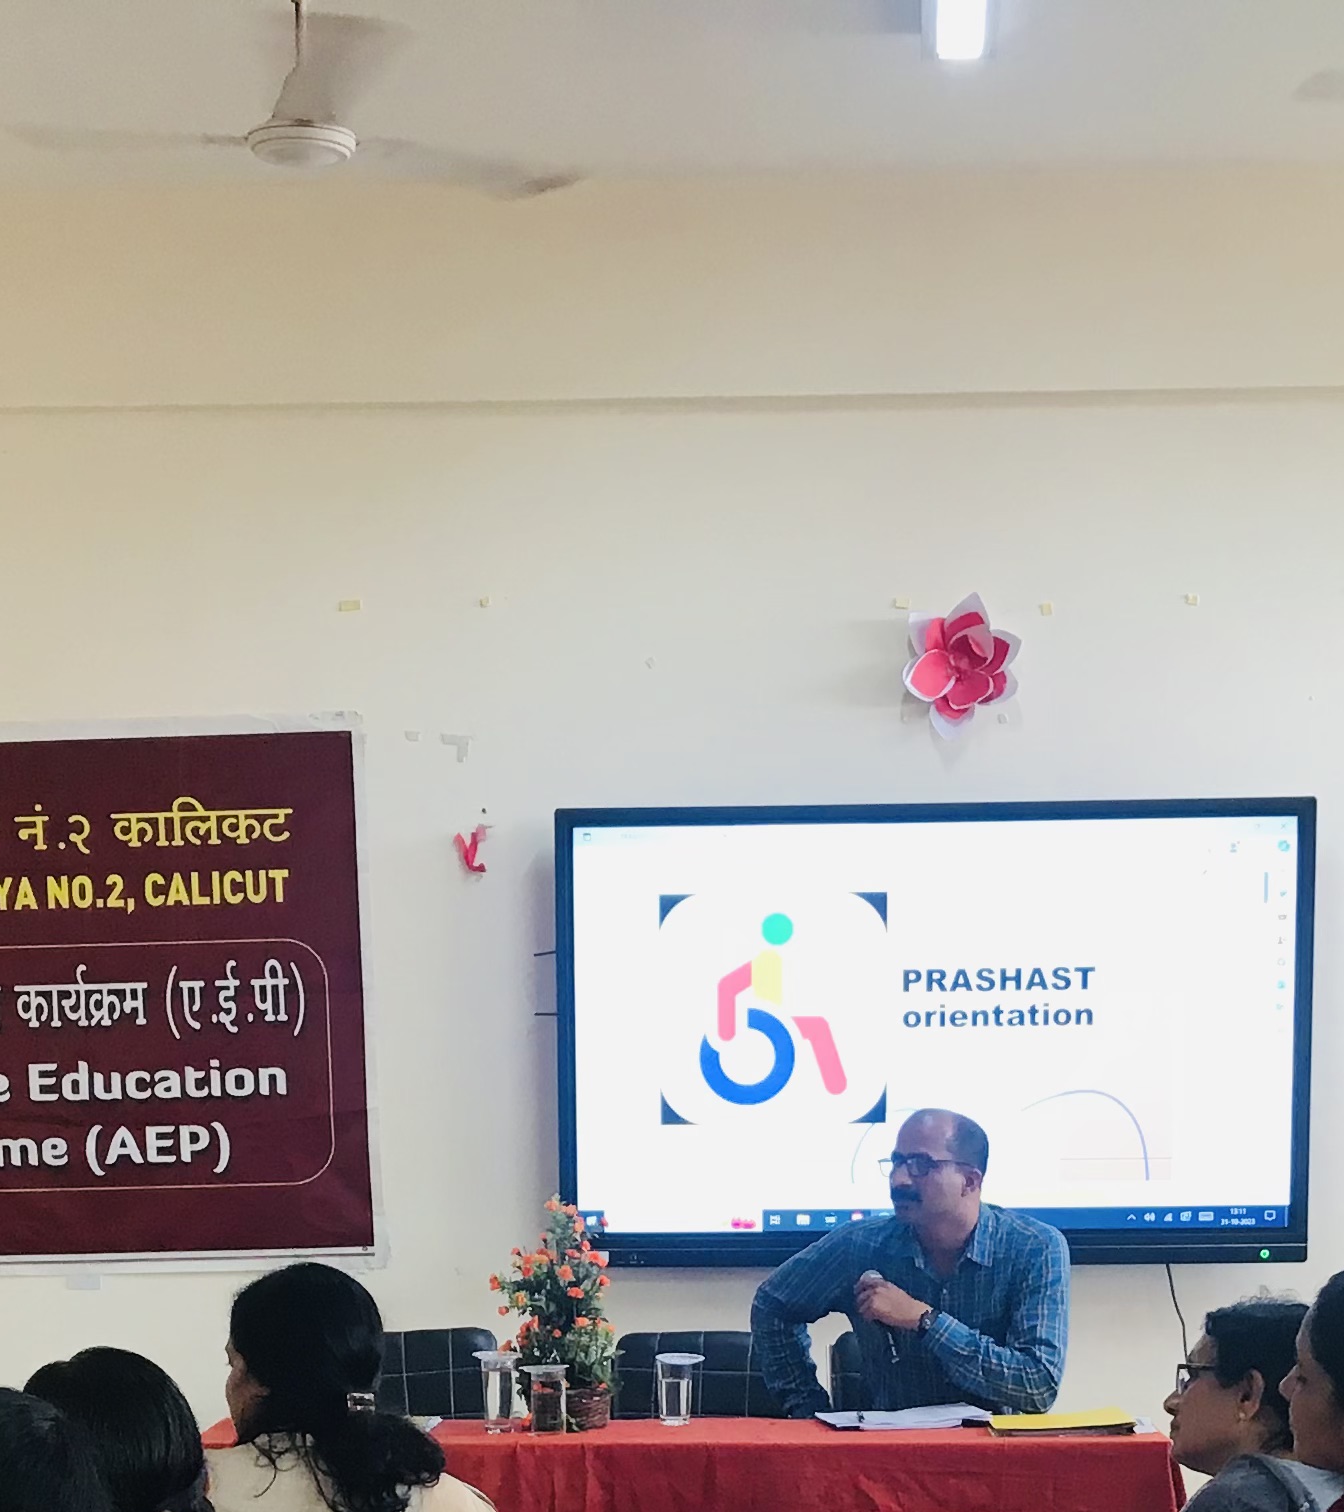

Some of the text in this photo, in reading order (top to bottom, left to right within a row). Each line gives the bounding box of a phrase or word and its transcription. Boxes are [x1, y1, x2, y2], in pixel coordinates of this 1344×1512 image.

[110, 796, 293, 846] कालिकट
[46, 874, 135, 915] NO.2,
[144, 869, 289, 906] CALICUT
[13, 964, 148, 1027] कार्यक्रम
[902, 966, 1096, 992] PRASHAST
[902, 1003, 1094, 1028] orientation
[27, 1059, 287, 1101] Education
[85, 1121, 230, 1176] (AEP)
